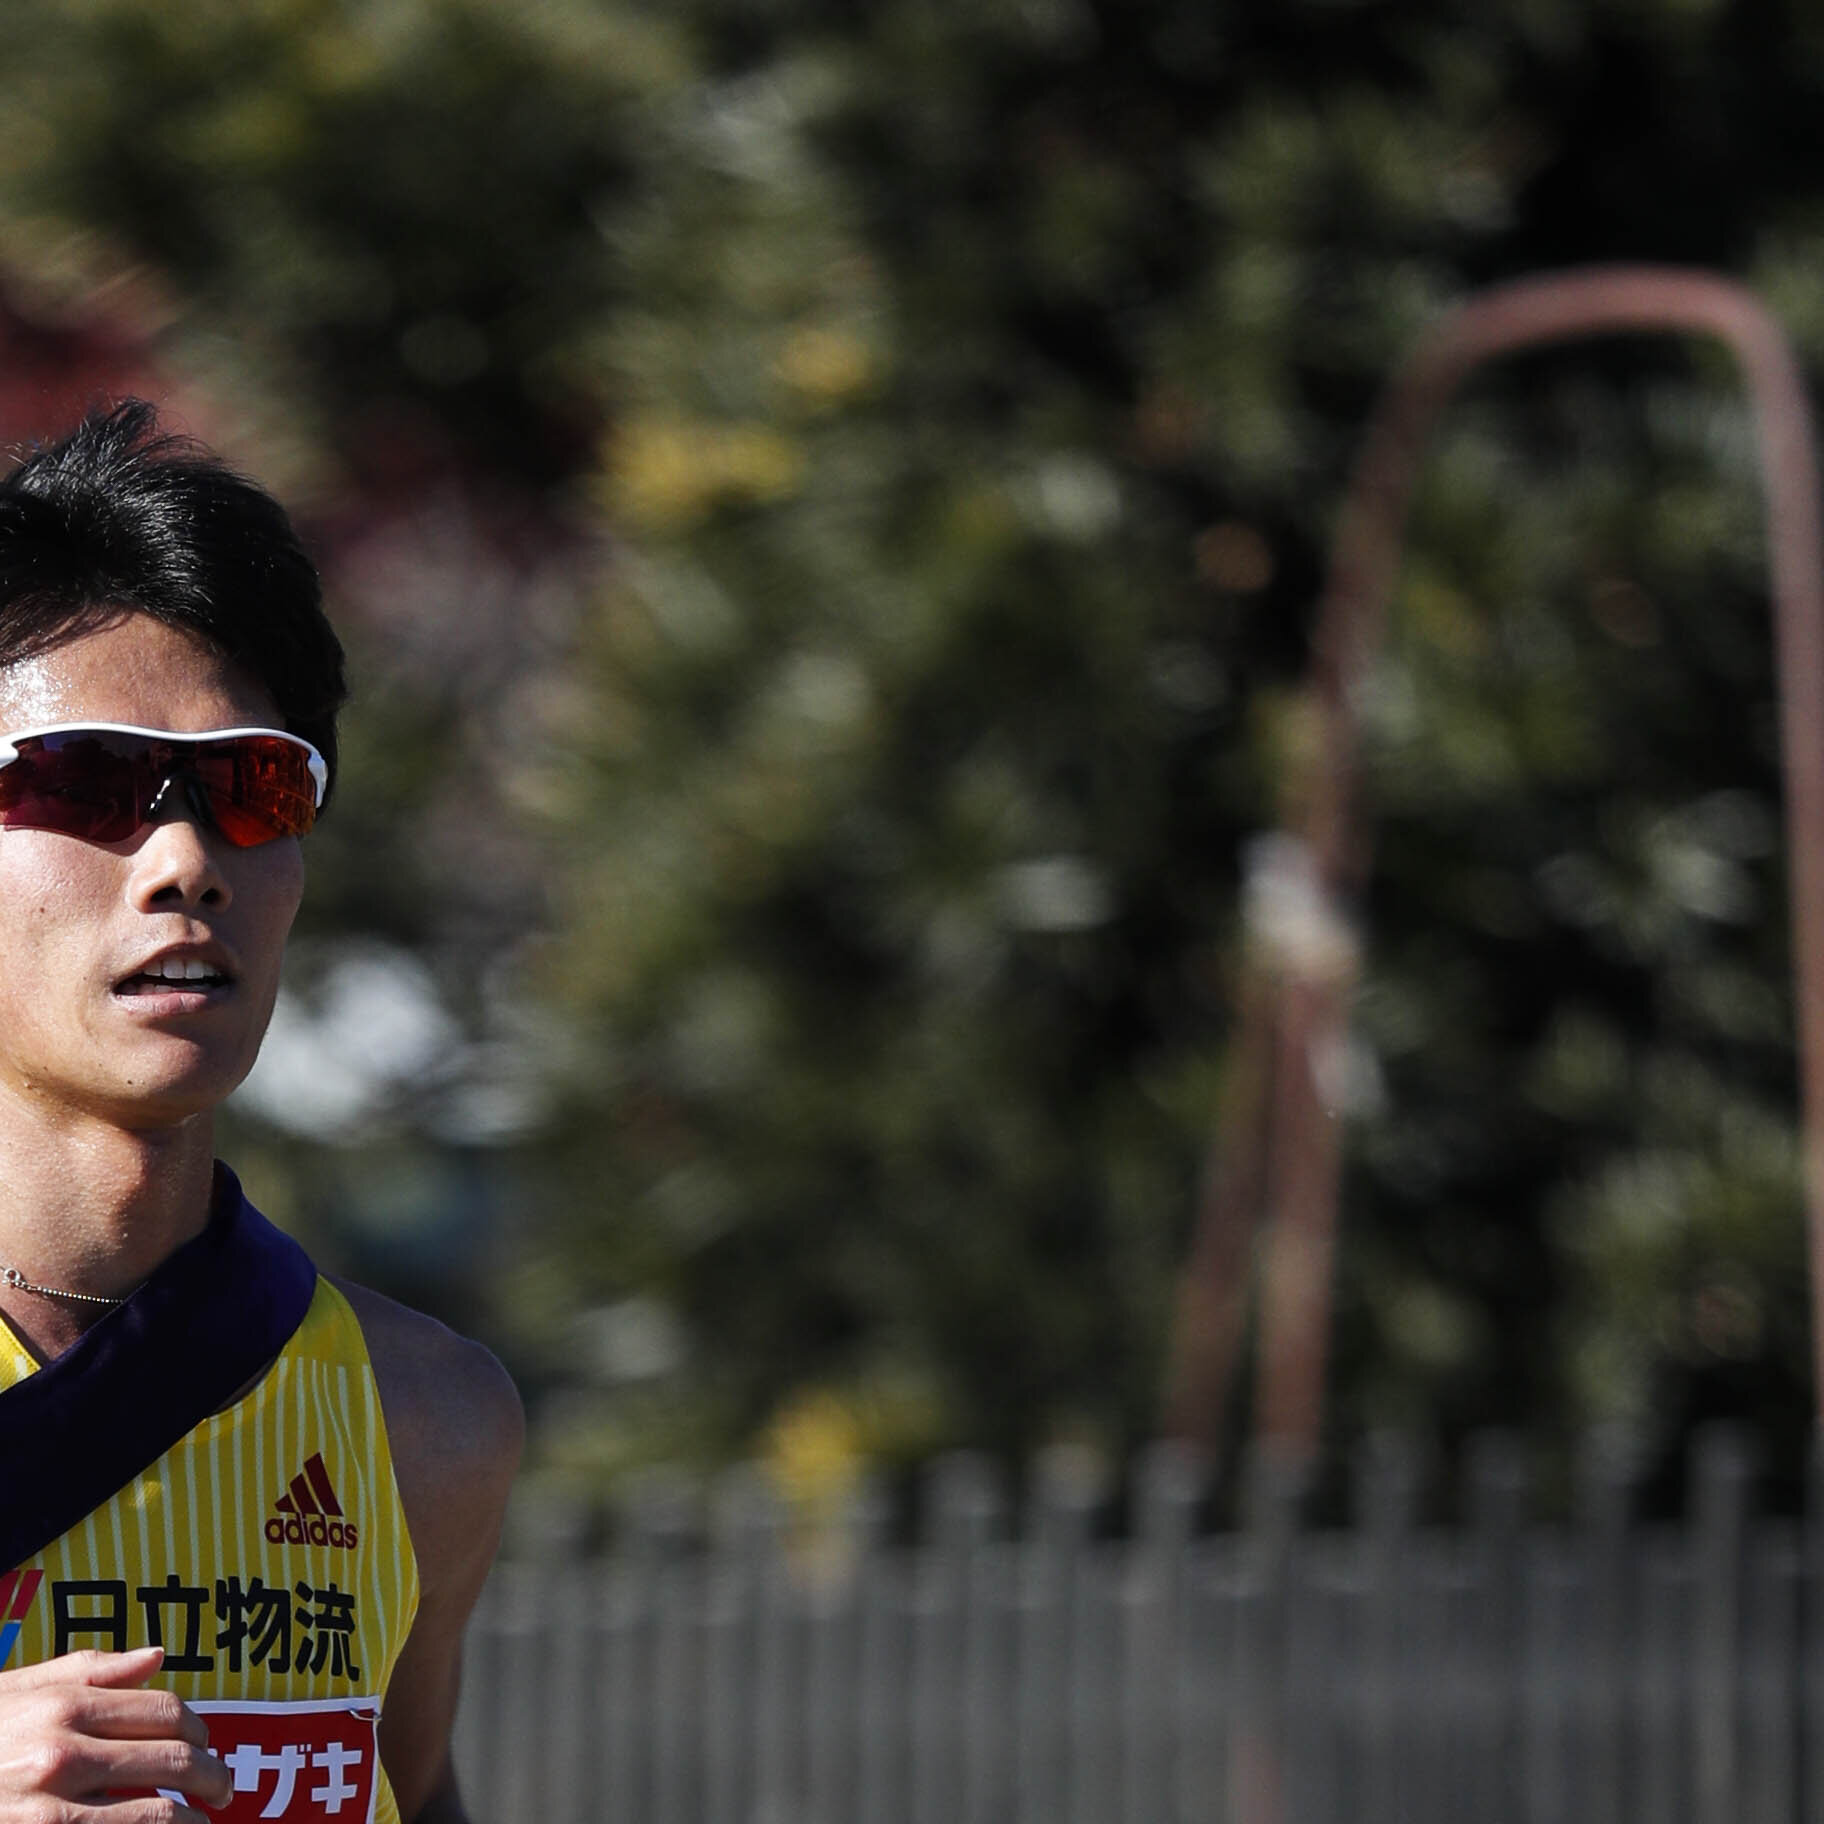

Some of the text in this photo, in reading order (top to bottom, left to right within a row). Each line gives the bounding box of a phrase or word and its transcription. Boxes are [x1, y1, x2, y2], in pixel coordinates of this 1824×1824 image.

[264, 1511, 358, 1550] adidas
[51, 1574, 360, 1682] 日立物流
[157, 1741, 363, 1819] ザキ
